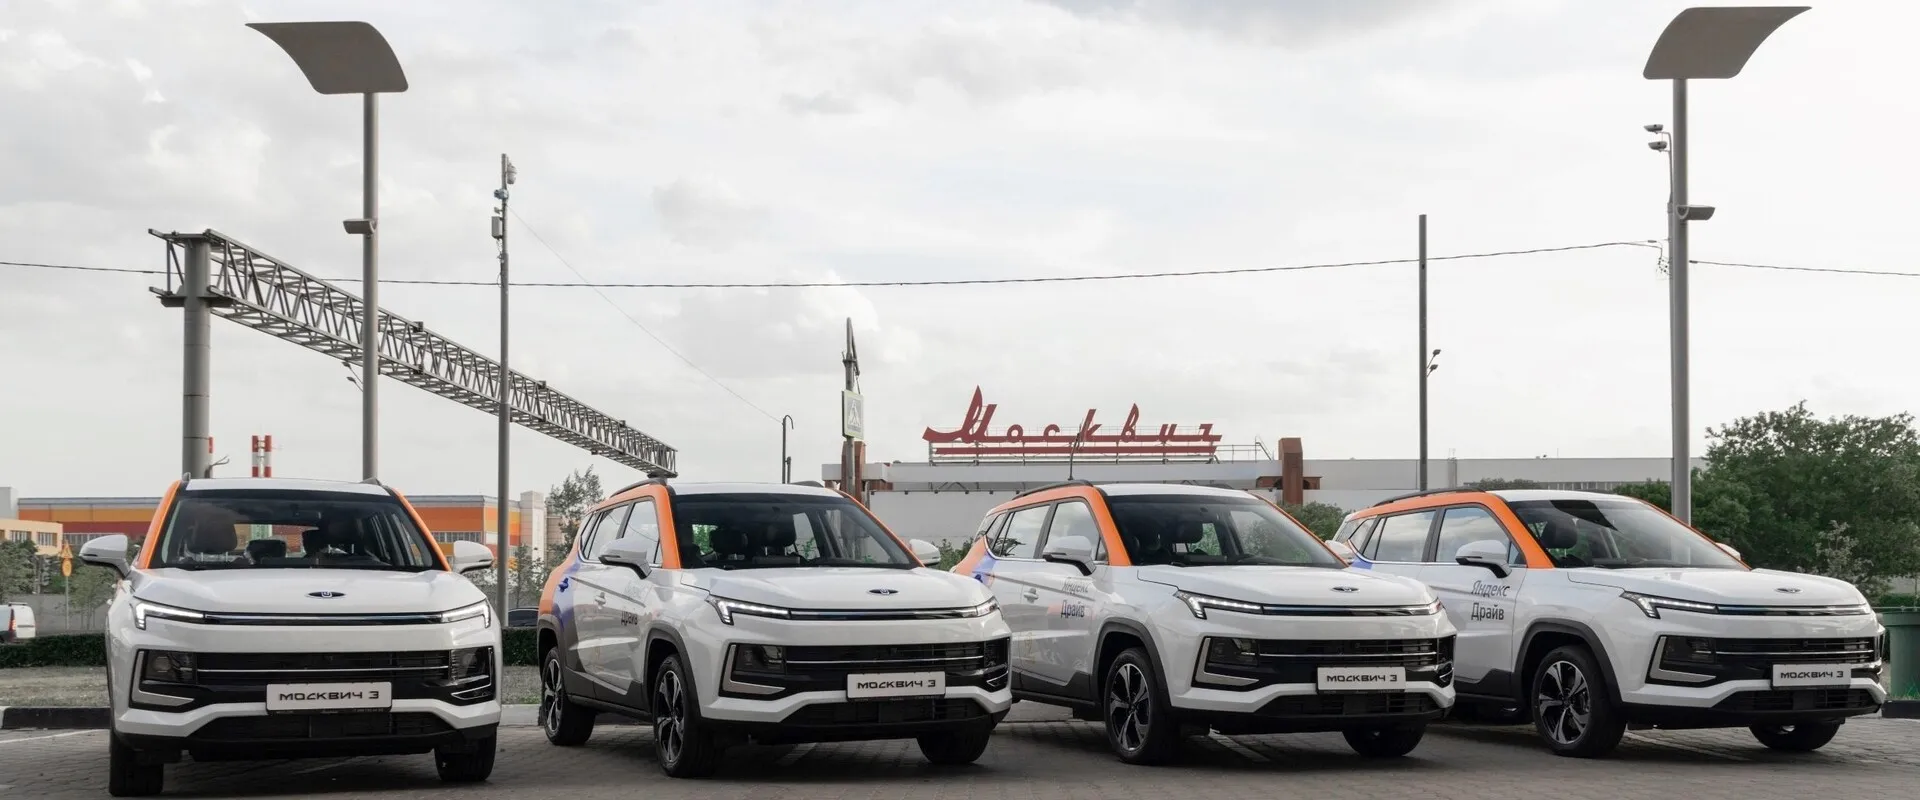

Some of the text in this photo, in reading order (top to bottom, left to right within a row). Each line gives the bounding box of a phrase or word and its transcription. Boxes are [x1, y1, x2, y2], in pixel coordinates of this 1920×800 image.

[922, 385, 1223, 443] Москвич
[1471, 580, 1510, 598] Яндекс
[1060, 599, 1085, 619] Драйв
[1471, 602, 1505, 621] Драйв
[1389, 674, 1397, 682] 3
[1836, 670, 1844, 678] 3
[927, 679, 936, 688] 3
[368, 690, 380, 699] 3
